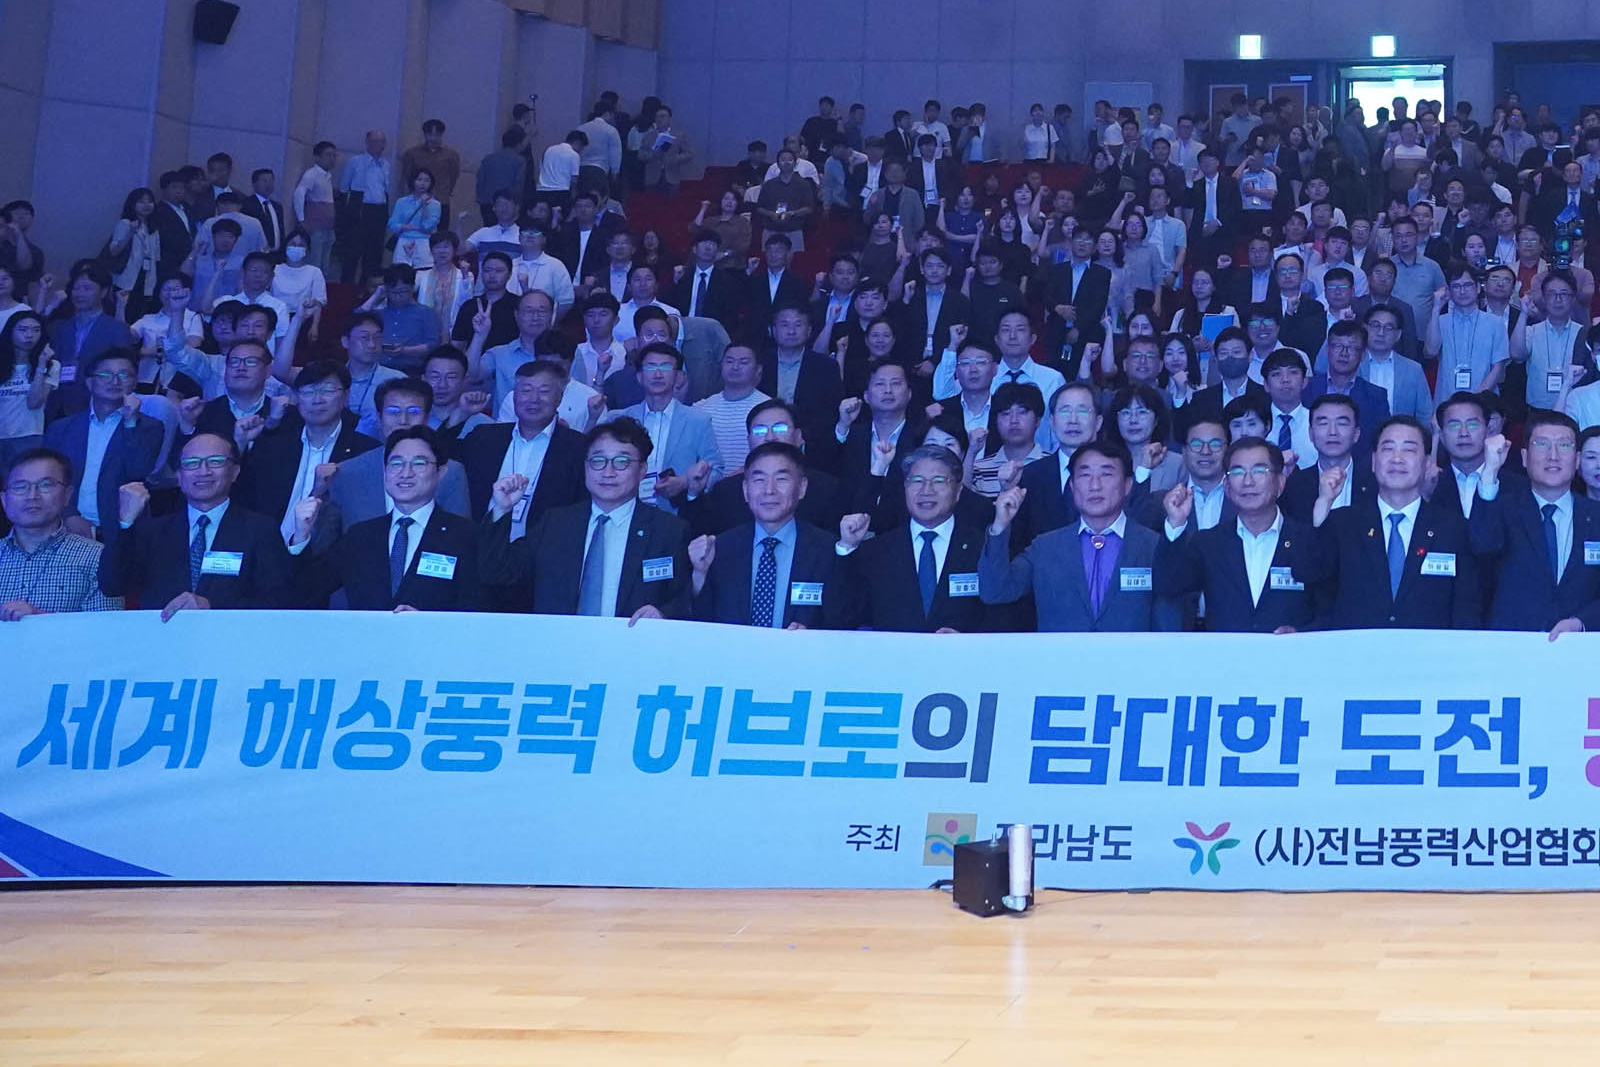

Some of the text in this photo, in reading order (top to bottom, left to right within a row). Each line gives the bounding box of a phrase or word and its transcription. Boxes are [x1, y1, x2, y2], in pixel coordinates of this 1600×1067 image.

[16, 679, 217, 770] 세계
[240, 679, 607, 773] 해상풍력
[633, 685, 999, 783] 허브로의
[1028, 695, 1309, 787] 담대한
[1335, 697, 1548, 800] 도전,
[846, 824, 900, 852] 주최
[996, 822, 1133, 863] 라남도
